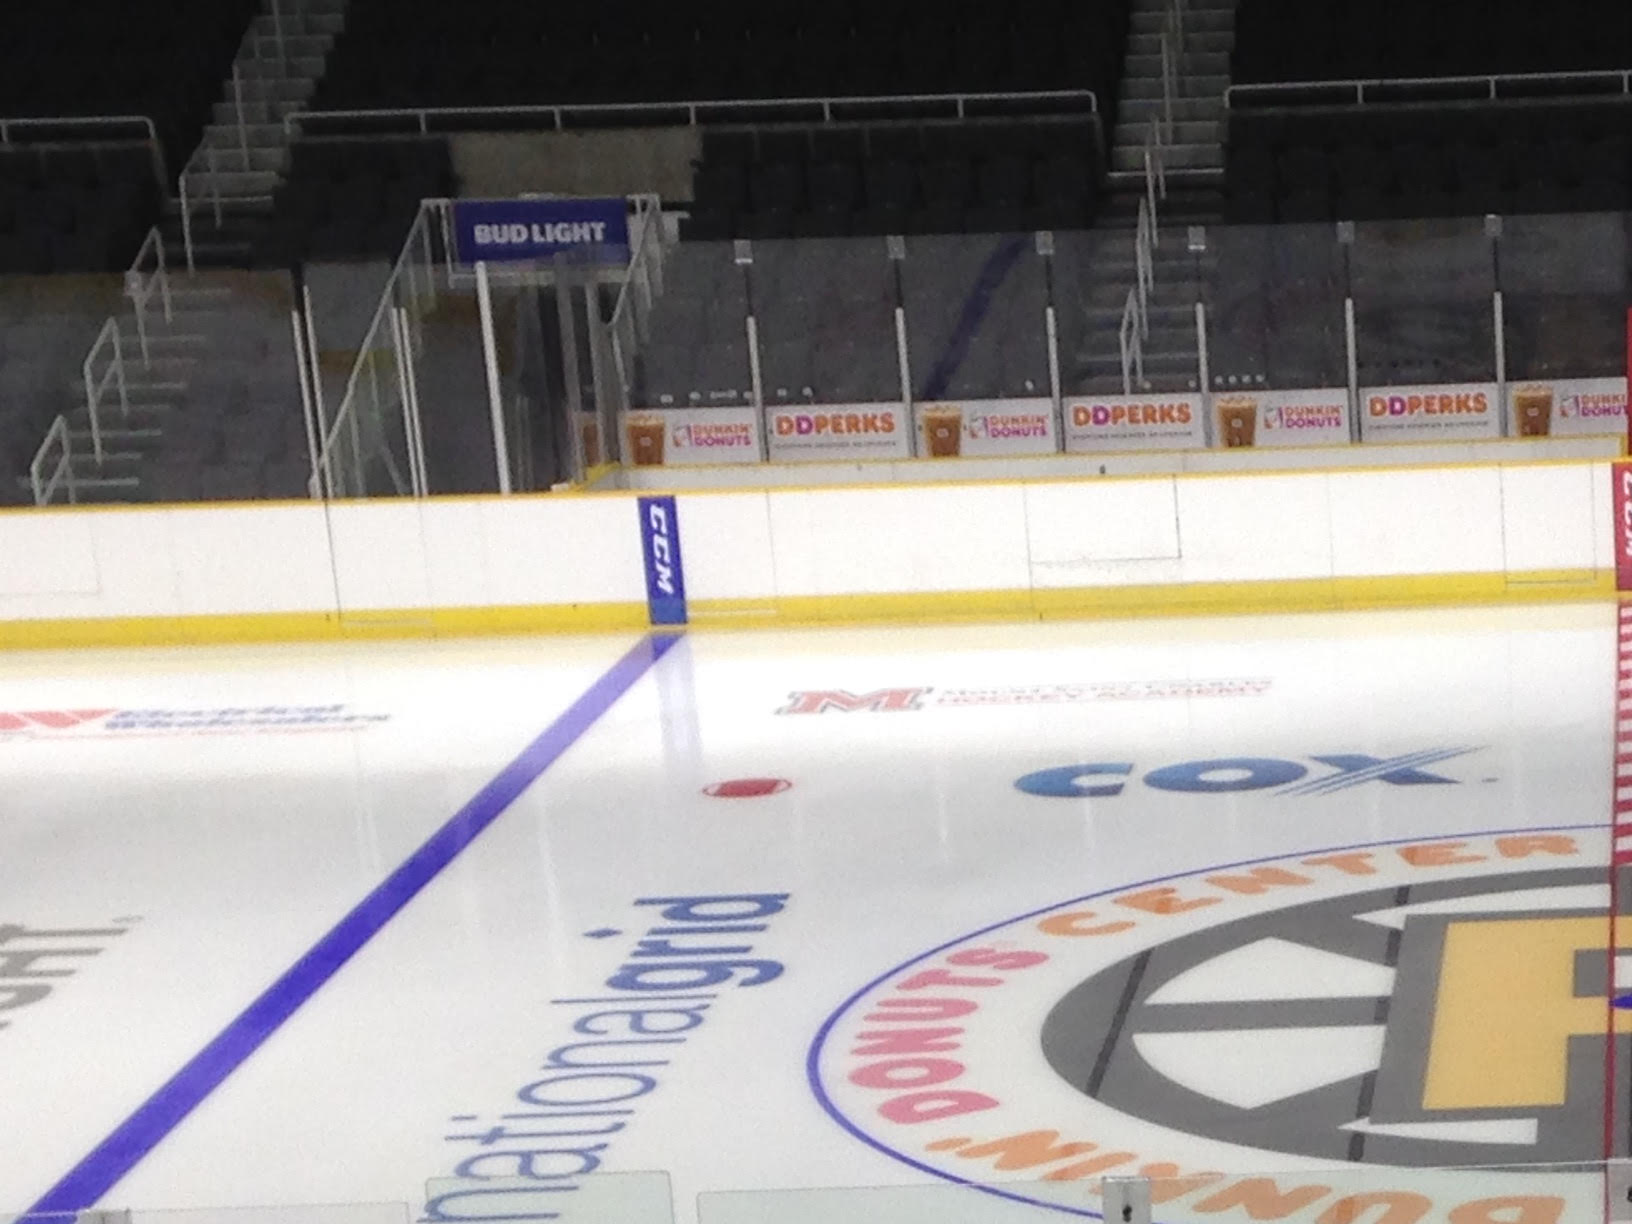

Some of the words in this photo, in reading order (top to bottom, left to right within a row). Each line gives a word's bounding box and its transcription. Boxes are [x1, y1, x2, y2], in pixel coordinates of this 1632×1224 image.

[473, 222, 529, 246] BUD
[531, 221, 607, 245] LIGHT
[1285, 415, 1343, 429] DONUTS
[1581, 405, 1627, 417] DONU
[694, 434, 752, 447] DONUTS
[991, 424, 1048, 438] DONUTS
[649, 503, 674, 595] CCM
[775, 687, 935, 716] M
[1013, 745, 1488, 798] COX
[848, 945, 1050, 1125] DONUTS
[1036, 833, 1583, 938] CENTER
